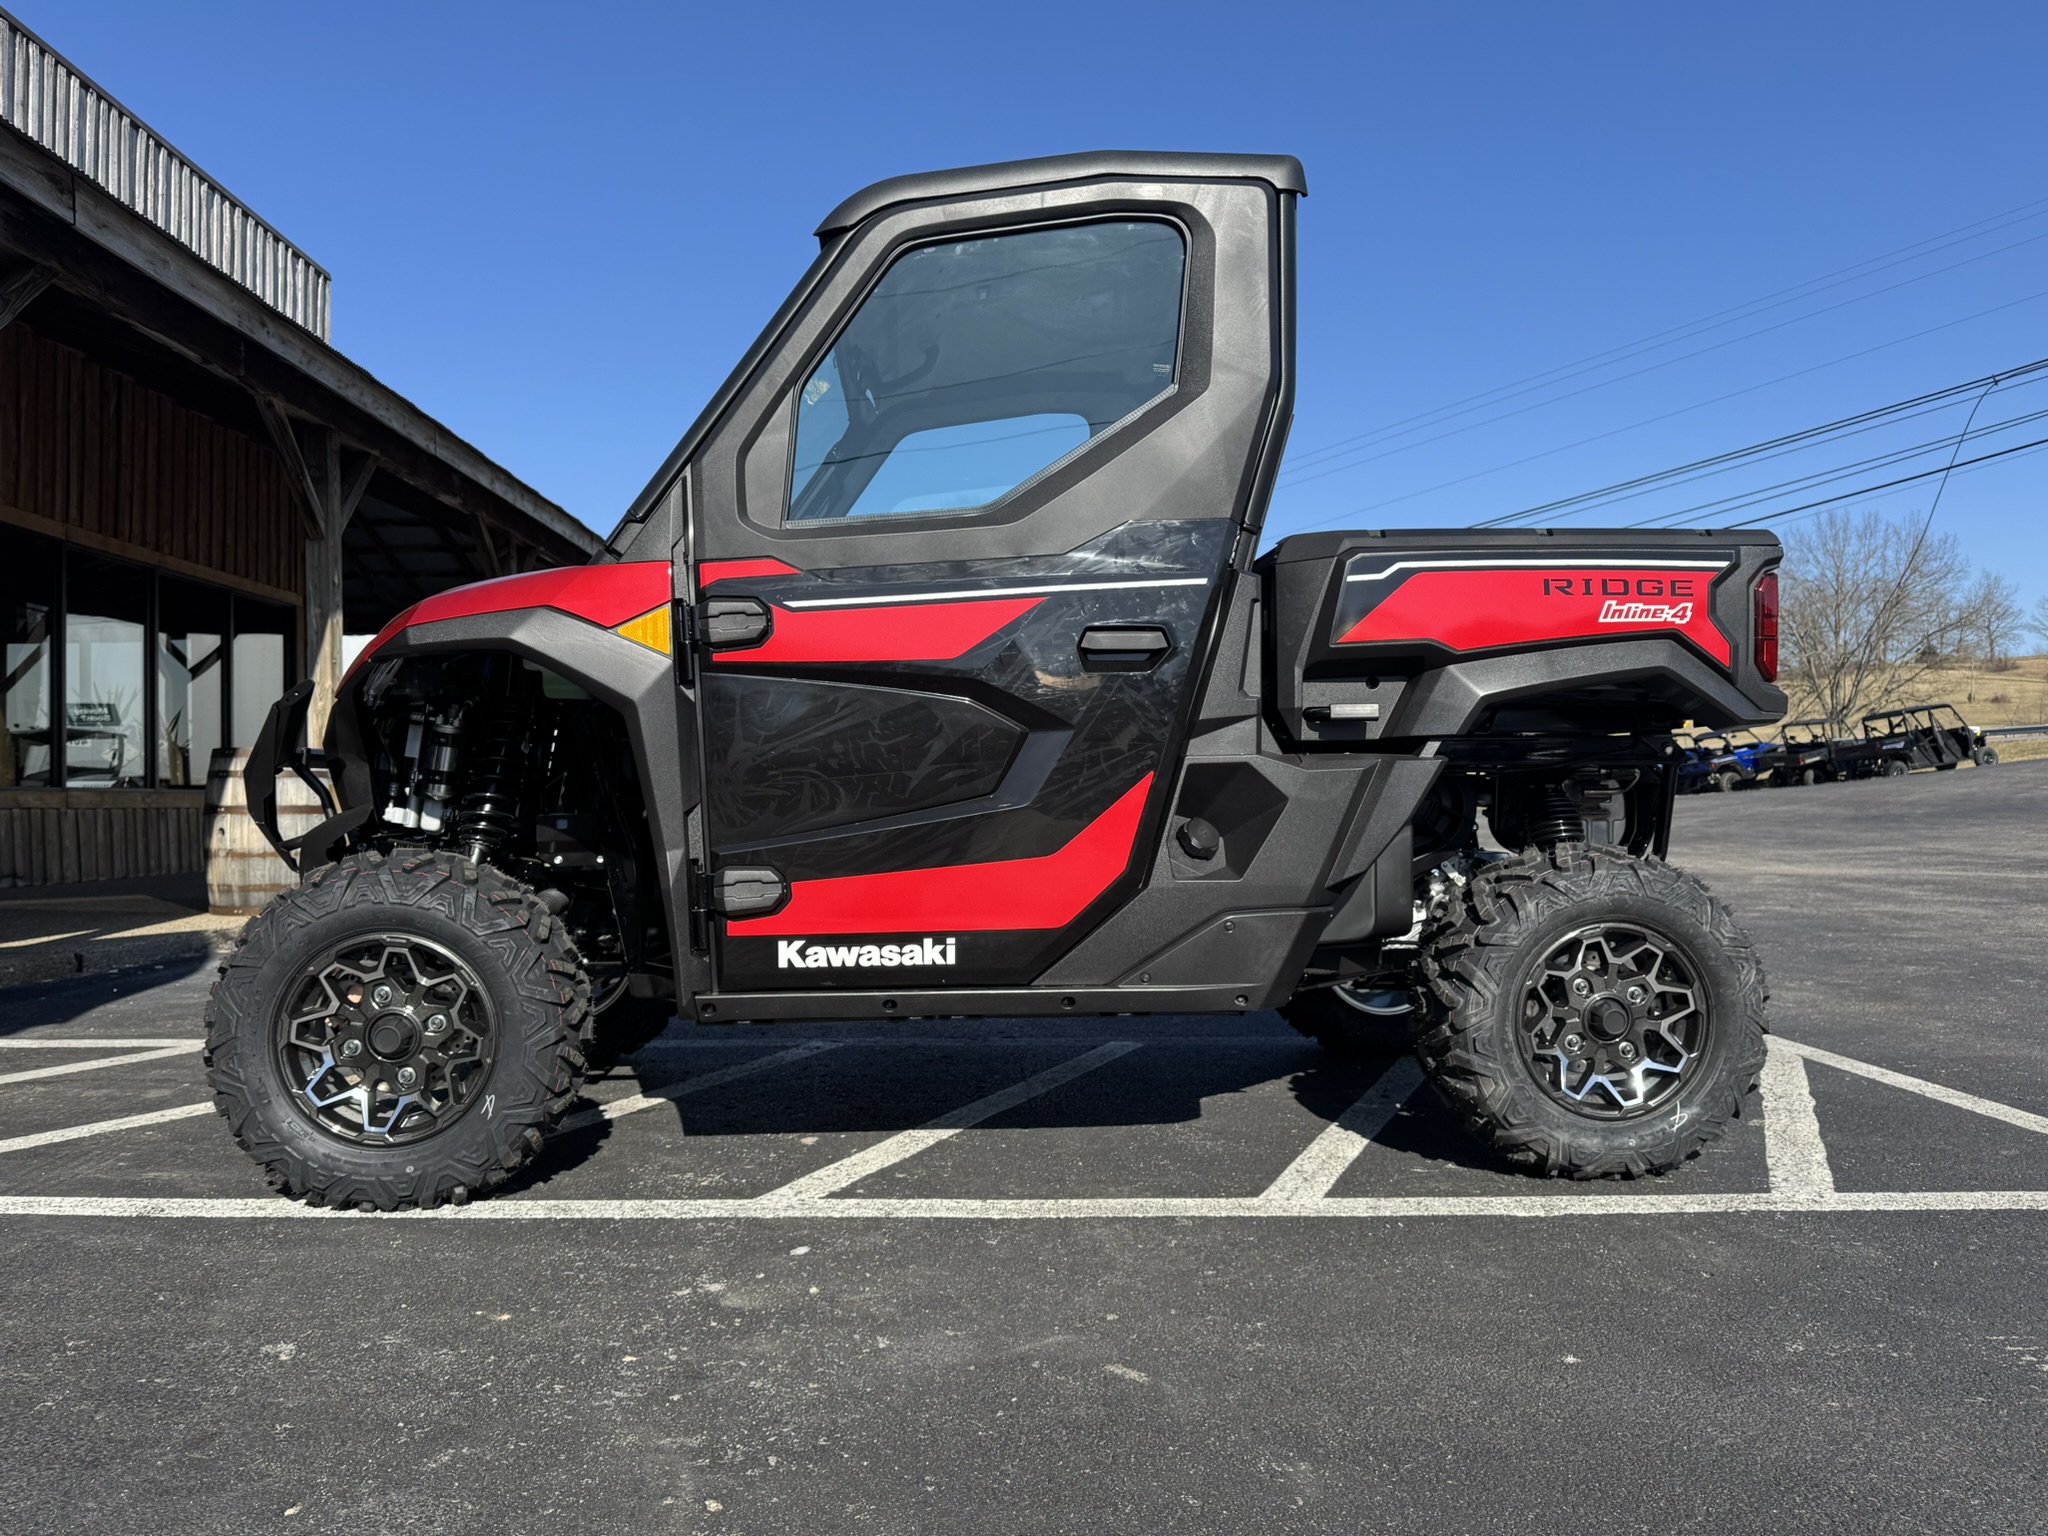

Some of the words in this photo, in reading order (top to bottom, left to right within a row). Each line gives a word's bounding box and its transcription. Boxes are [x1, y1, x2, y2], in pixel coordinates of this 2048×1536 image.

[1543, 578, 1694, 597] RIDGE
[1598, 600, 1693, 624] Inline-4
[777, 937, 956, 968] Kawasaki
